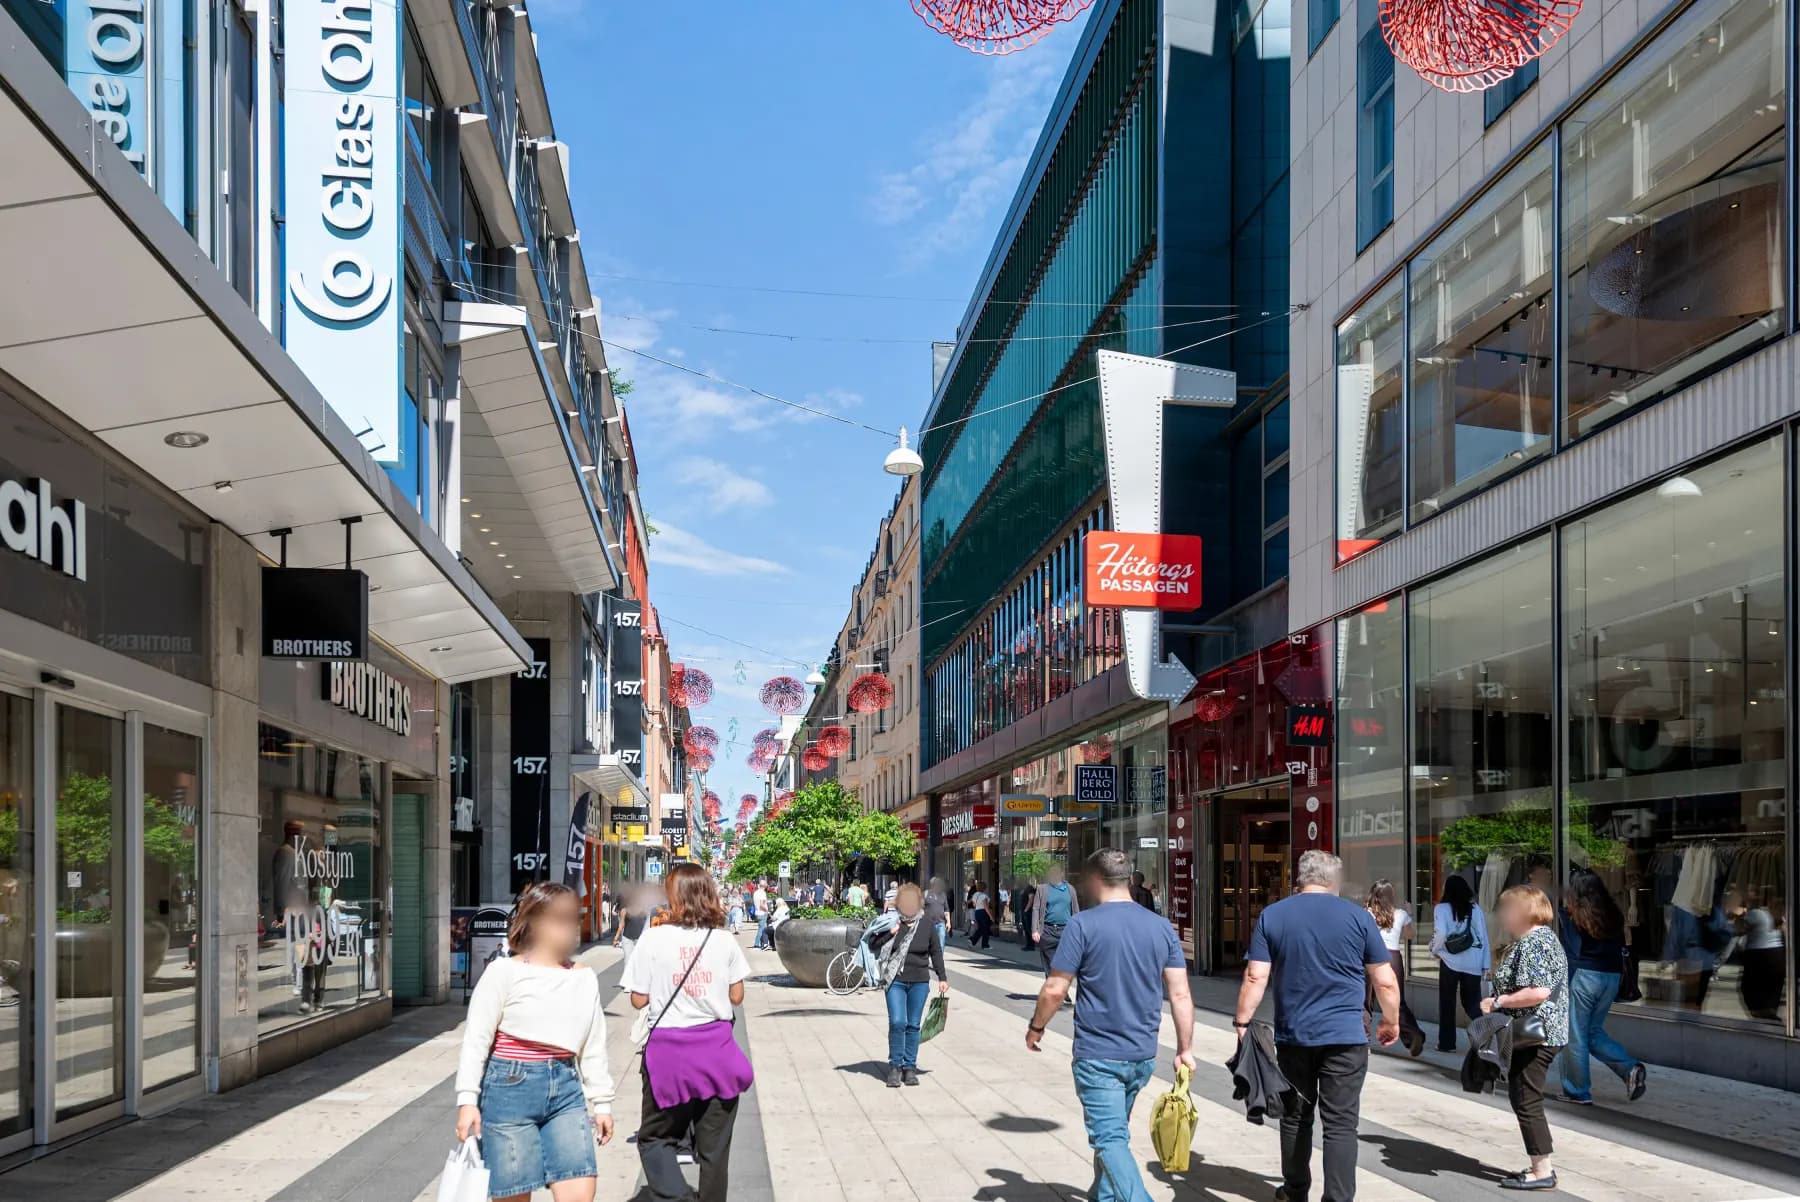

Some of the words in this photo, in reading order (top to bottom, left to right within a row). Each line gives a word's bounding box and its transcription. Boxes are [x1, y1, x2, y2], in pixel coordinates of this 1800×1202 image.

[321, 97, 373, 230] Clas
[1097, 543, 1195, 581] Hötorgs
[1101, 579, 1189, 594] PASSAGEN
[273, 639, 353, 657] BROTHERS
[331, 662, 411, 737] BROTHERS
[1293, 715, 1325, 737] H&M
[1082, 770, 1111, 779] HALL
[1082, 790, 1112, 799] GULD
[612, 813, 648, 821] stadium
[941, 811, 979, 837] DRESSMAN
[294, 835, 354, 889] Kostym
[474, 921, 508, 929] BROTHERS
